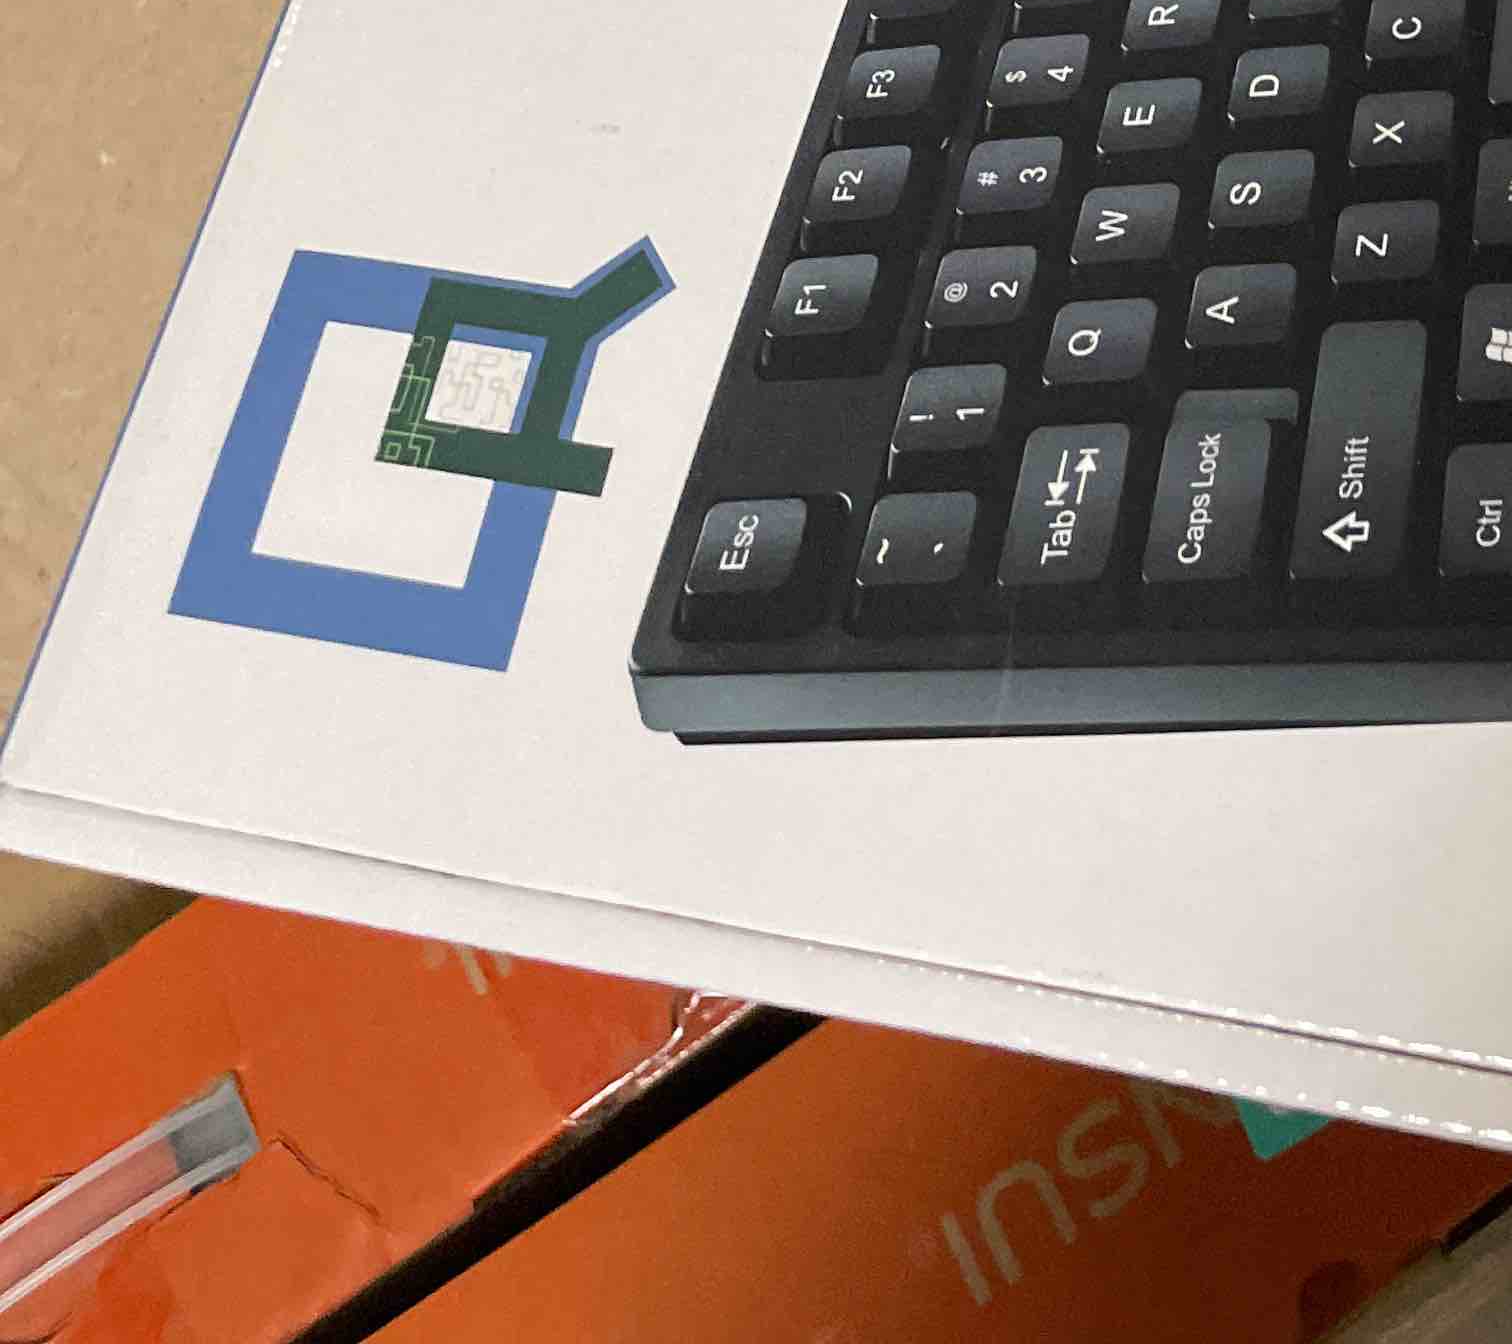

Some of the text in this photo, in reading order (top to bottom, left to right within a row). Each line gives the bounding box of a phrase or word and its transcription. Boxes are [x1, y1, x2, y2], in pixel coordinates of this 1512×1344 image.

[1147, 3, 1180, 28] R
[1391, 15, 1423, 41] C
[865, 67, 897, 100] F3
[1046, 64, 1076, 83] 4
[1247, 72, 1281, 99] D
[1121, 103, 1157, 128] E
[1371, 118, 1407, 146] X
[831, 167, 865, 204] F2
[976, 169, 1001, 188] #
[1017, 165, 1050, 185] 3
[1228, 180, 1262, 207] S
[1094, 208, 1130, 244] W
[1354, 231, 1390, 258] Z
[793, 282, 829, 317] F1
[942, 281, 970, 303] @
[988, 279, 1020, 299] 2
[1204, 294, 1242, 325] A
[1067, 327, 1102, 357] Q
[954, 406, 986, 422] 1
[1337, 434, 1371, 501] Shift
[1176, 432, 1222, 566] Caps Lock
[1475, 498, 1505, 548] Ctrl
[718, 512, 761, 573] Esc
[1040, 507, 1078, 567] Tab
